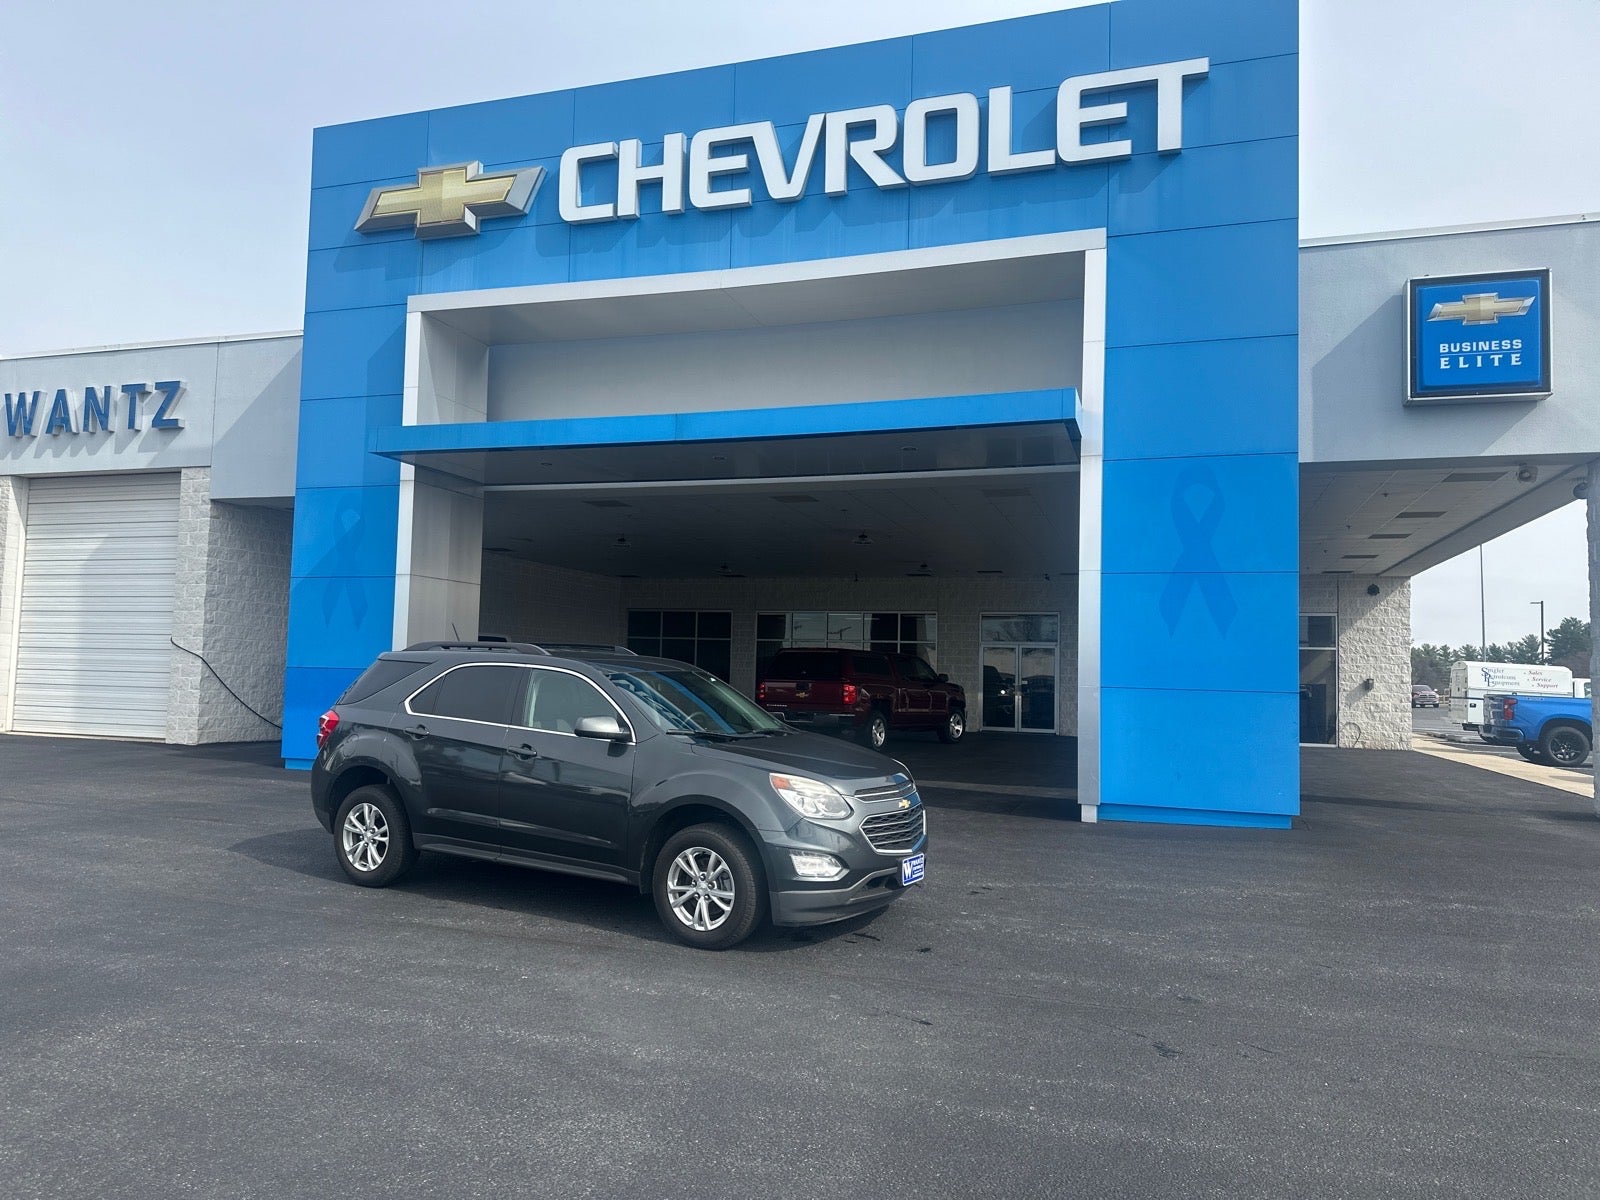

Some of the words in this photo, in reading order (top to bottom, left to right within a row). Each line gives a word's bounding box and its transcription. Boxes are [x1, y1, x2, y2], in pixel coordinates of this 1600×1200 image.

[558, 57, 1210, 223] CHEVROLET
[1439, 339, 1522, 353] BUSINESS
[1439, 353, 1522, 369] ELITE
[4, 380, 187, 438] WANTZ
